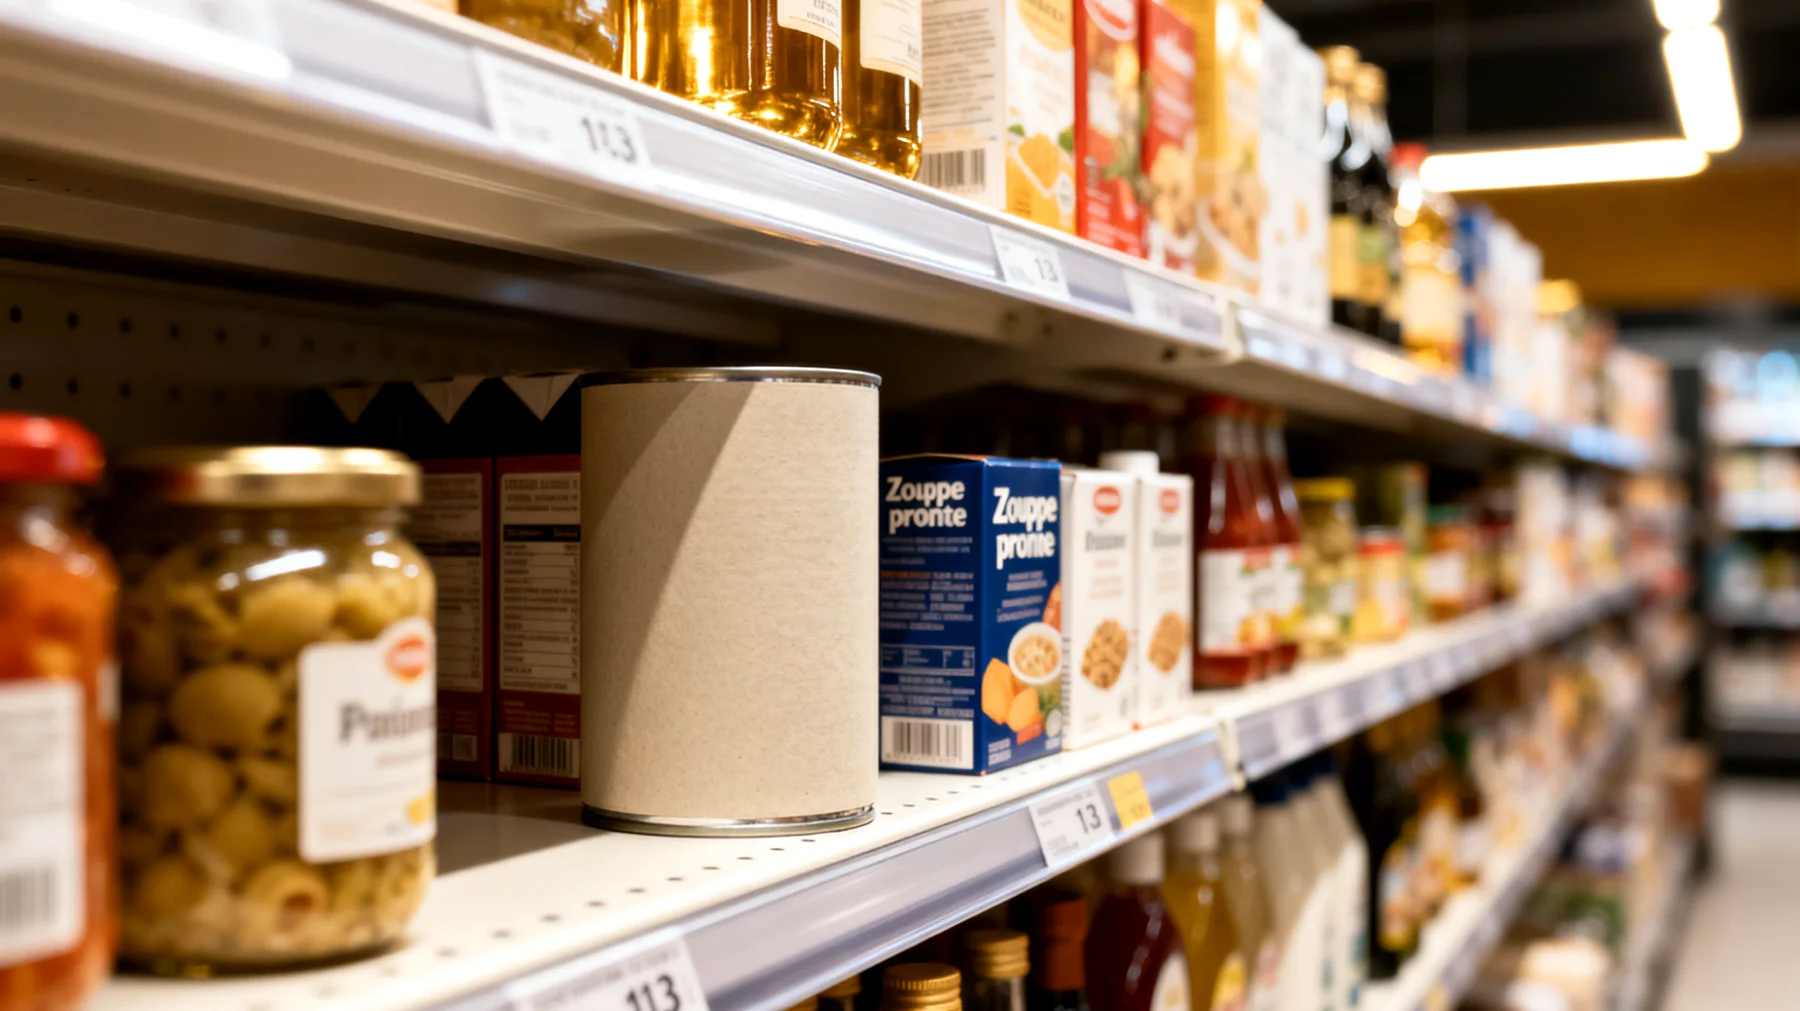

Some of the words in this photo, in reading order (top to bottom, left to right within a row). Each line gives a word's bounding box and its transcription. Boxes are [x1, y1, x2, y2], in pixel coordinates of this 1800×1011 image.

[1034, 256, 1059, 283] 13
[889, 505, 968, 535] pronte
[992, 486, 1058, 532] Zouppe
[1075, 803, 1103, 834] 13
